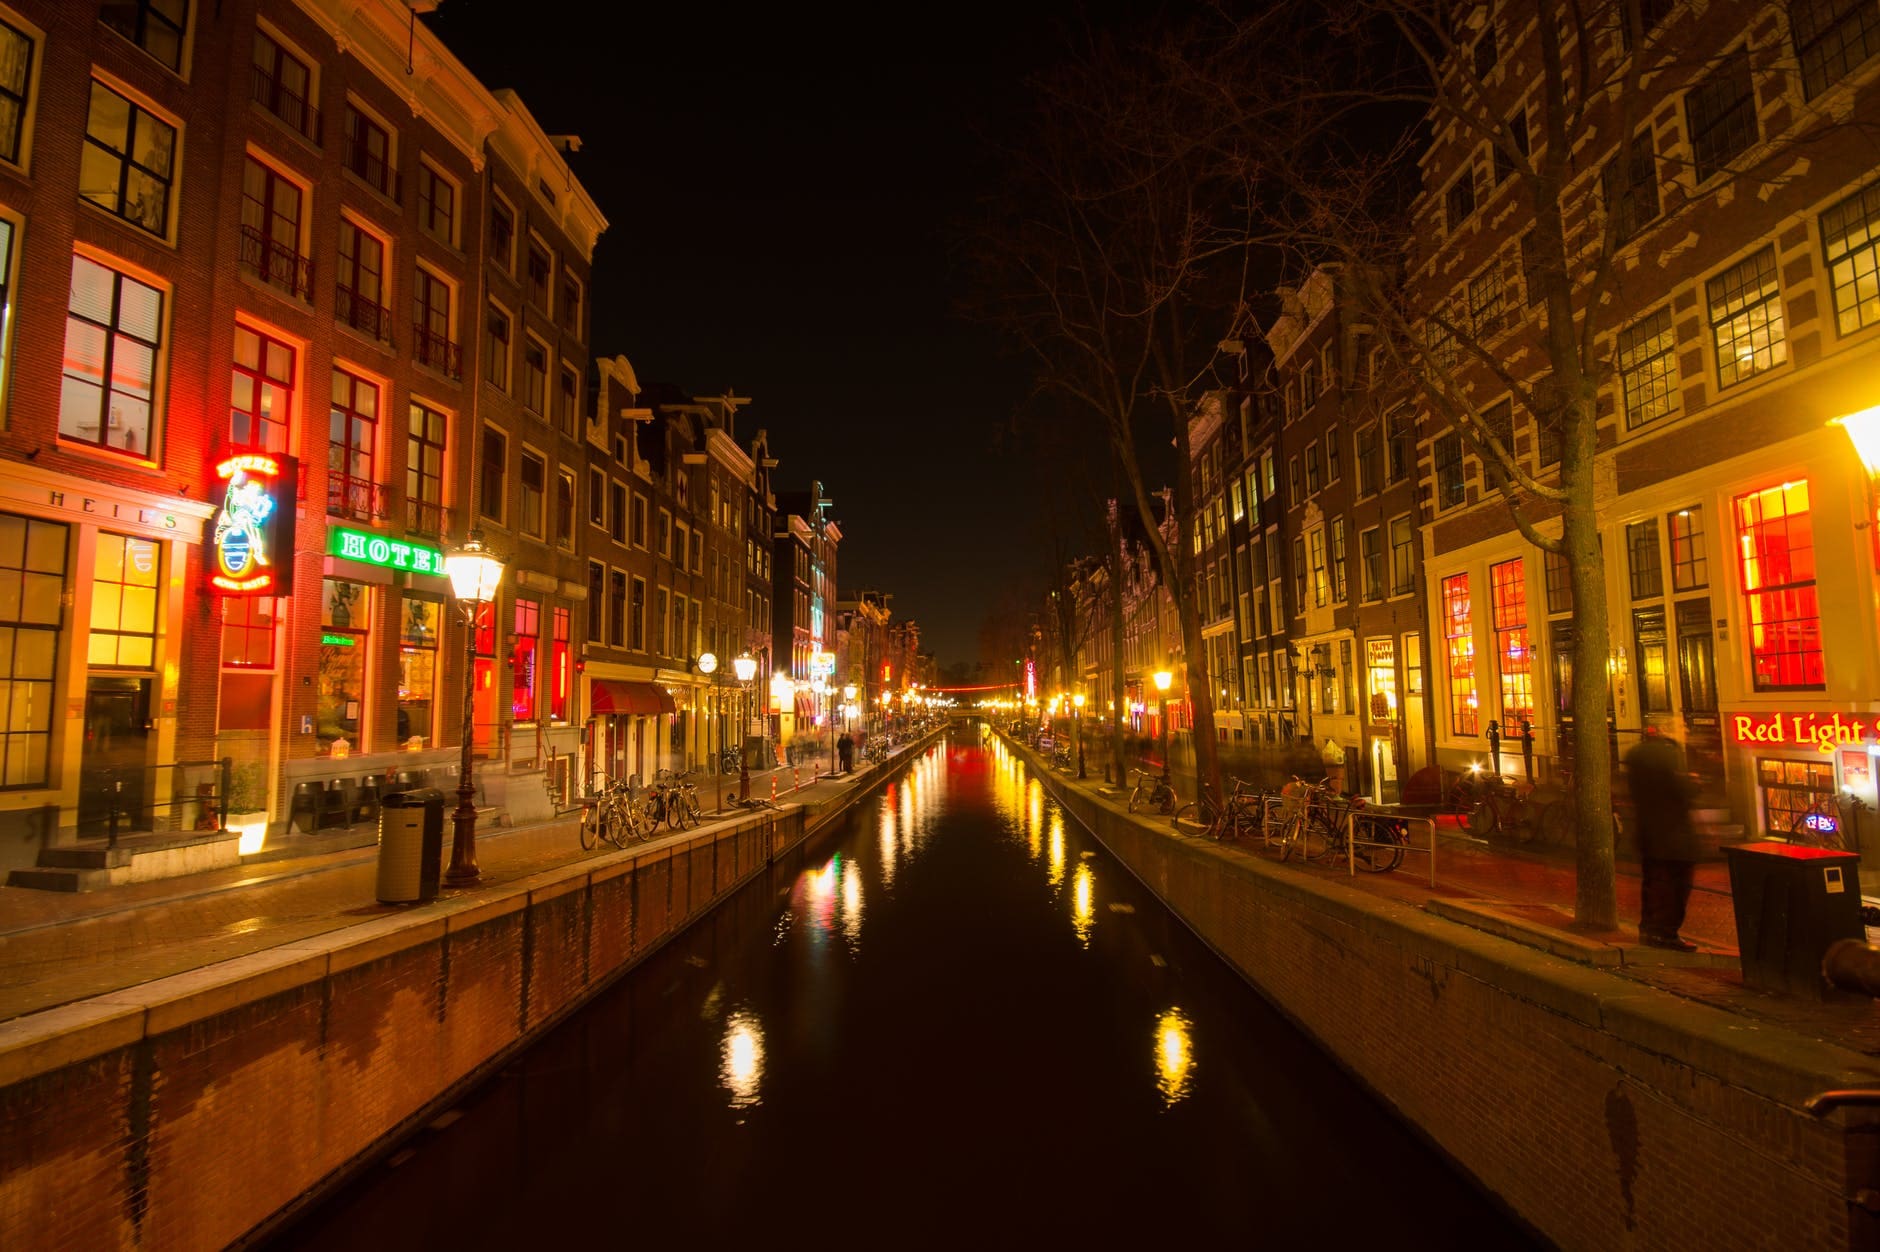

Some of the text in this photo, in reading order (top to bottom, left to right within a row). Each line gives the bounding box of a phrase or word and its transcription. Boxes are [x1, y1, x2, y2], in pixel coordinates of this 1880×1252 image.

[51, 491, 177, 528] HEILS
[341, 532, 449, 574] HOTEL
[1735, 713, 1784, 742] Red
[1792, 713, 1865, 754] Light
